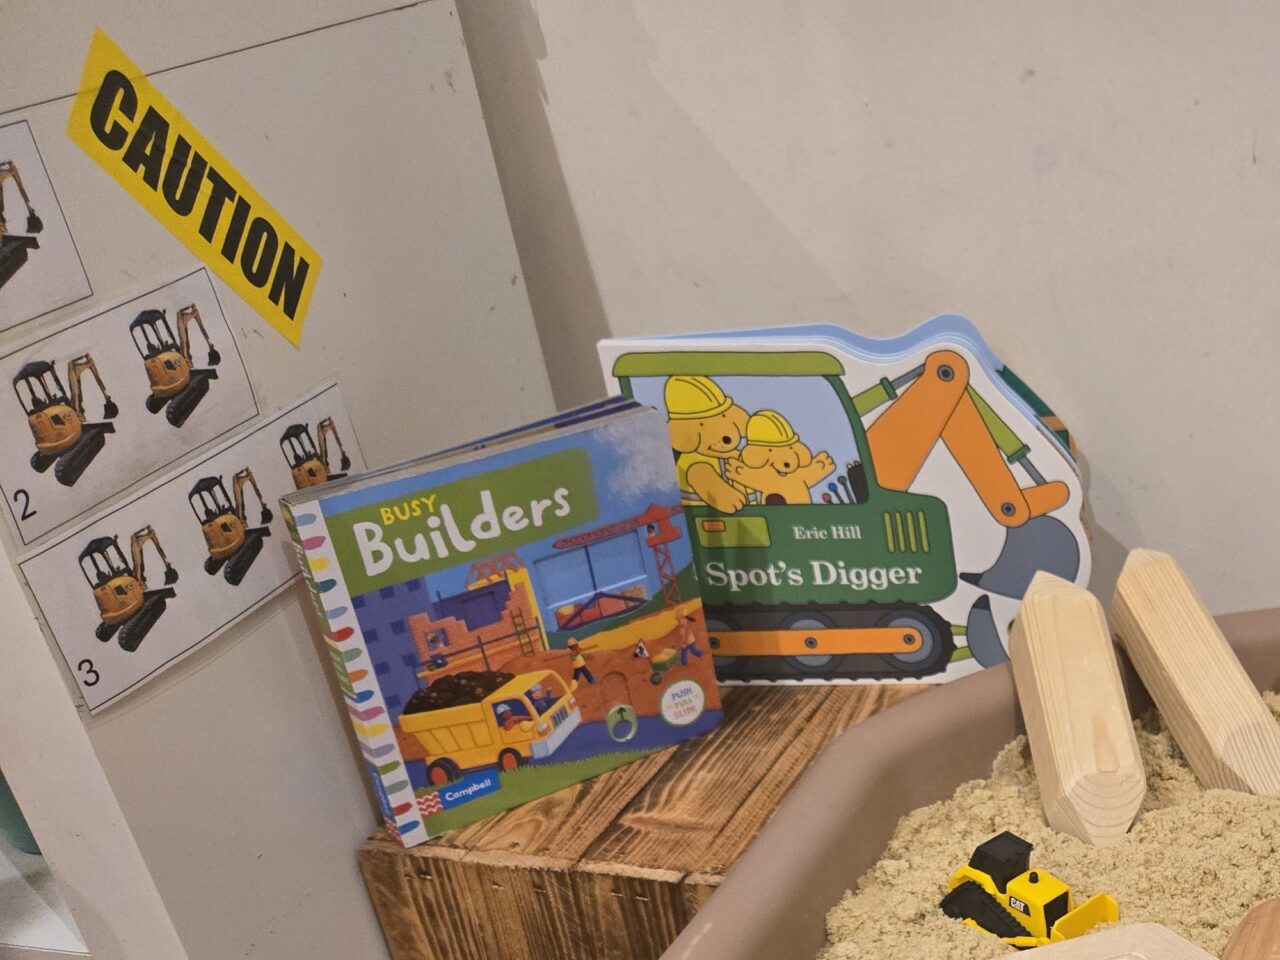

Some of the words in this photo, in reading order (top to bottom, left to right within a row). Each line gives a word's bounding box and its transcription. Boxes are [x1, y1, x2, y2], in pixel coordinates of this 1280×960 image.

[89, 69, 310, 320] CAUTION
[13, 489, 37, 521] 2
[379, 494, 438, 526] BUSY
[353, 488, 570, 576] Builders
[792, 525, 825, 540] Eric
[829, 525, 862, 540] Hill
[706, 560, 803, 592] Spot's
[811, 560, 923, 591] Digger
[77, 659, 100, 687] 3
[671, 686, 693, 701] PUSH
[445, 778, 492, 801] Campbell
